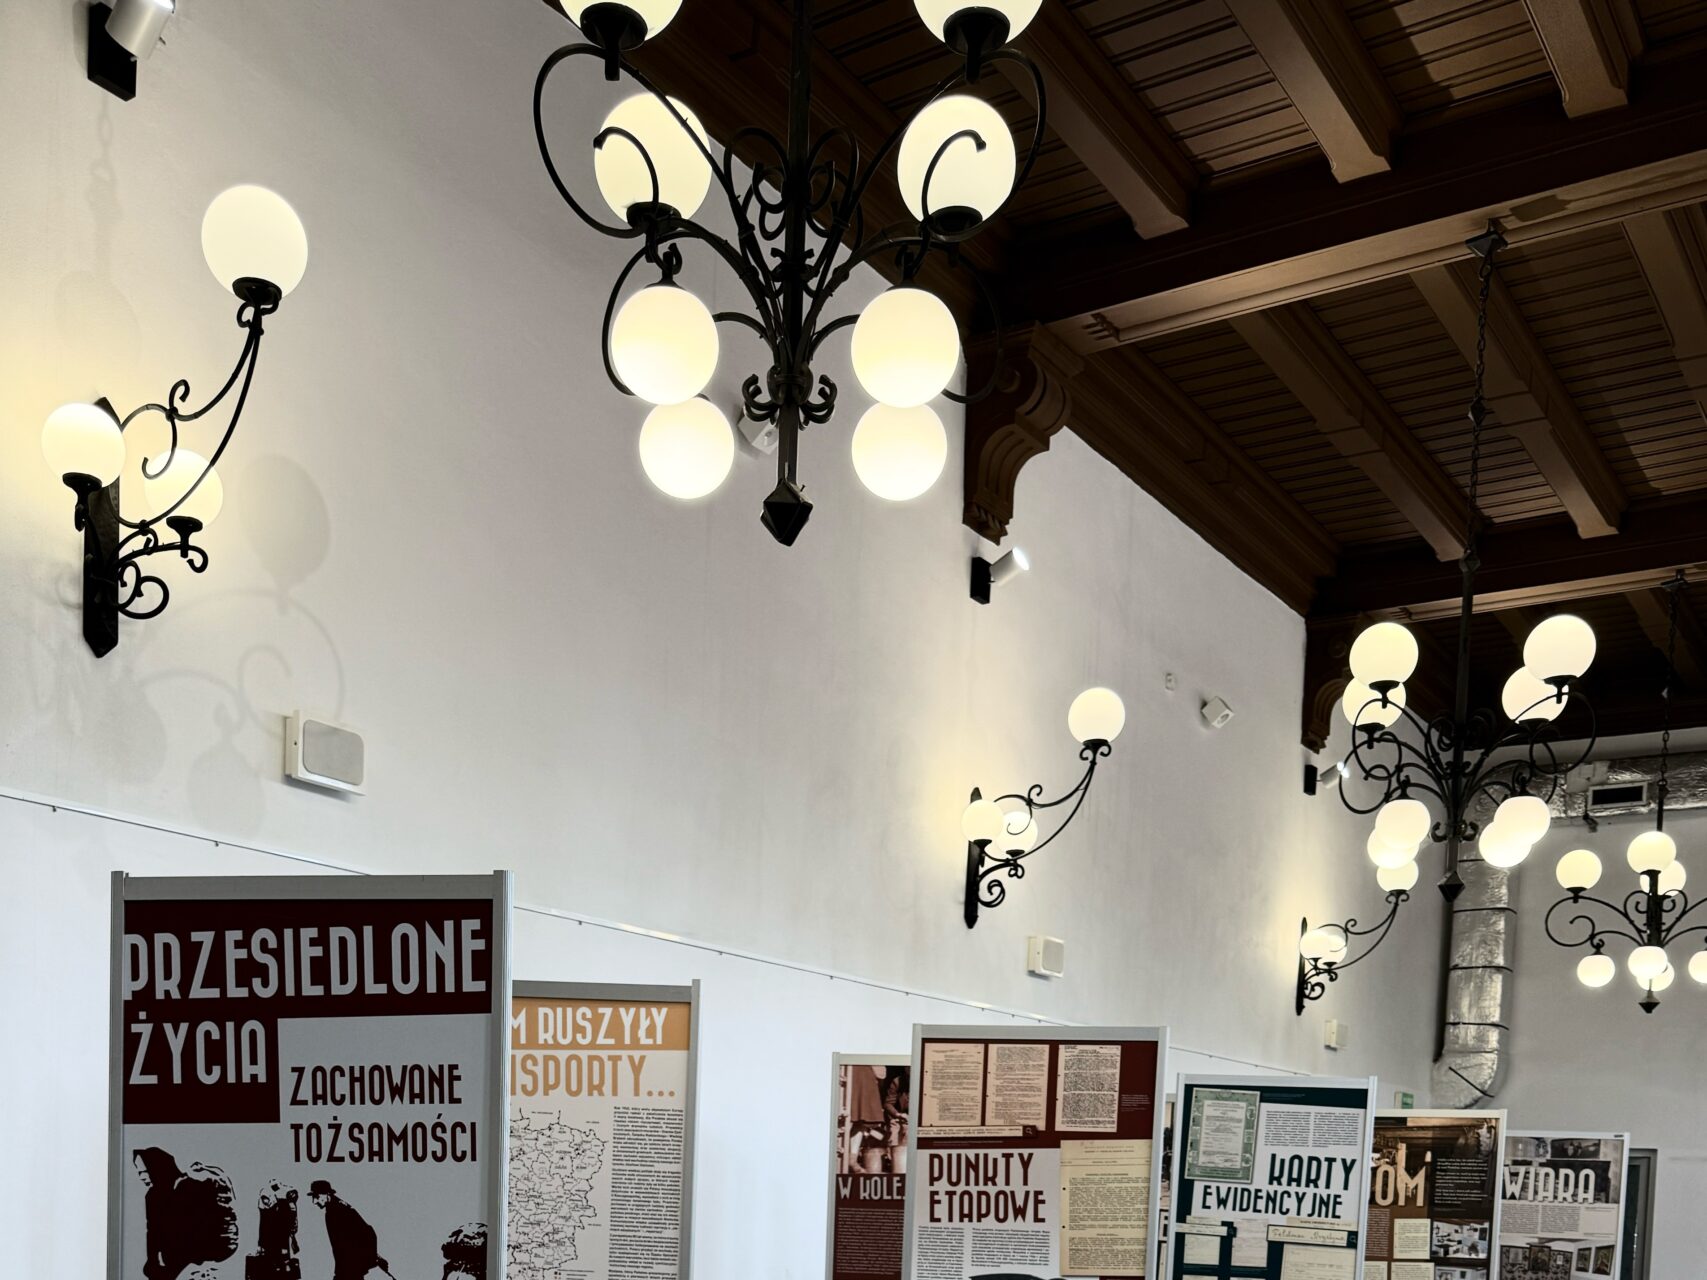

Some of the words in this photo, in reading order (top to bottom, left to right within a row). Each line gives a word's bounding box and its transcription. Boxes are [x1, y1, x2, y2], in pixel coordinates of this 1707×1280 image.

[124, 919, 486, 1000] PRZESIEDLONE
[538, 1006, 668, 1045] RUSZYŁY
[129, 1011, 267, 1085] ŻYCIA
[289, 1064, 462, 1106] ZACHOWANE
[290, 1113, 477, 1163] TOŻSAMOŚCI
[838, 1176, 853, 1200] W
[859, 1176, 906, 1200] KOLE
[929, 1153, 1034, 1187] PUNKTY
[1268, 1153, 1357, 1191] KARTY
[1503, 1166, 1596, 1204] WIARA
[929, 1190, 1047, 1224] ETAPOWE
[1201, 1185, 1343, 1219] EWIDENCYJNE
